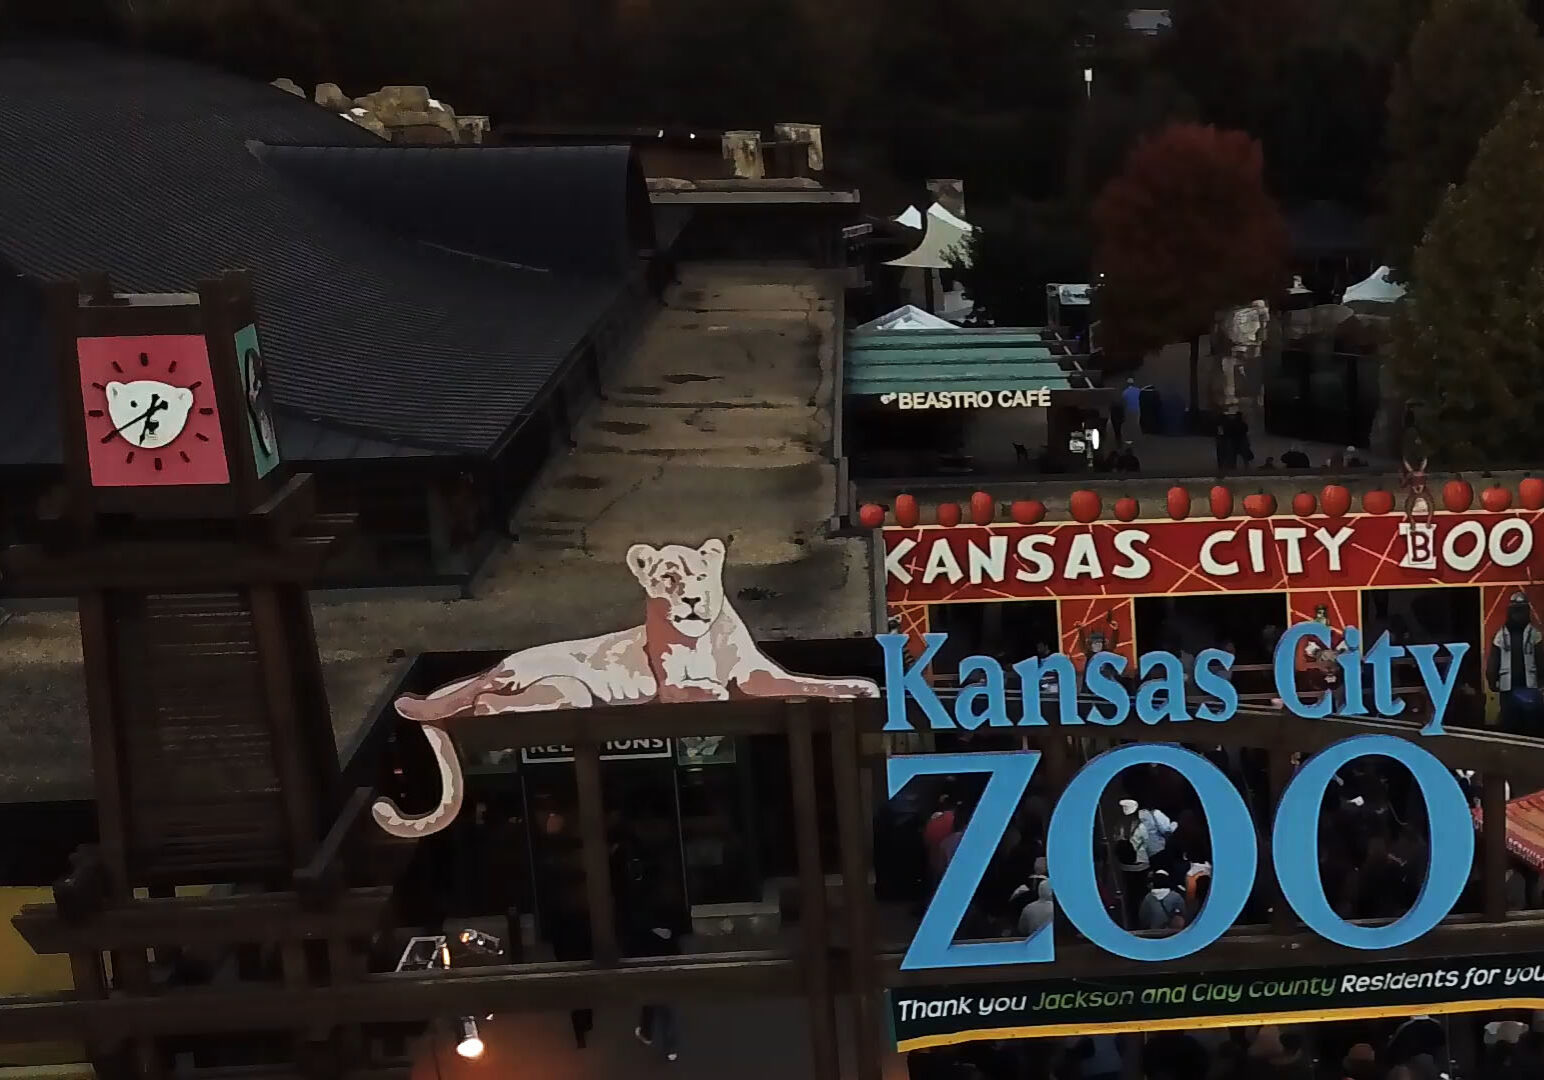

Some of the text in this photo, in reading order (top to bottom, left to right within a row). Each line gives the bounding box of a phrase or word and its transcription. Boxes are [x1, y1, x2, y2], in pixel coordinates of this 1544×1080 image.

[898, 386, 1051, 409] BEASTRO CAFÉ
[885, 517, 1534, 584] KANSAS CITY BOO
[875, 621, 1471, 736] Kansas City
[886, 733, 1476, 972] ZOO
[898, 992, 972, 1022] Thank
[977, 994, 1027, 1021] you
[1032, 984, 1135, 1012] Jackson
[1140, 981, 1187, 1005] and
[1191, 980, 1245, 1003] Clay
[1249, 975, 1337, 1000] County
[1340, 967, 1459, 994] Residents
[1460, 966, 1502, 991] for
